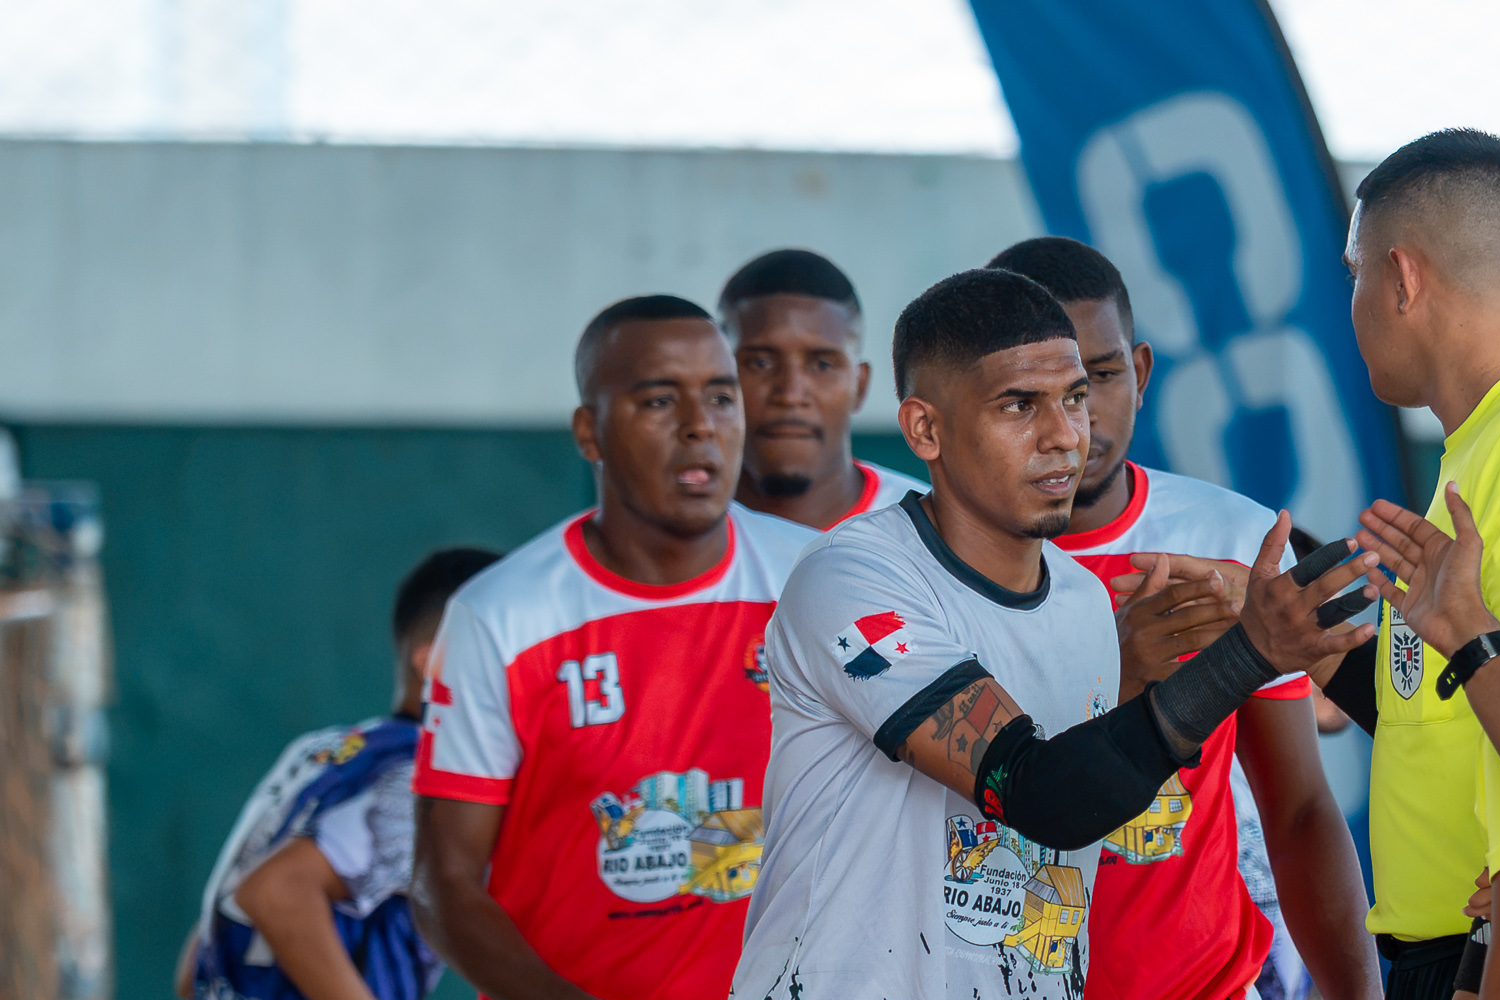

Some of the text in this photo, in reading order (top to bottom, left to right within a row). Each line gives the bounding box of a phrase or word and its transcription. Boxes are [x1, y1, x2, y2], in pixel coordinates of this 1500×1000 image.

[556, 651, 626, 729] 13
[603, 852, 688, 873] RIO ABAJO
[980, 864, 1027, 882] Fundación
[943, 885, 1021, 919] RIO ABAJO
[991, 886, 1012, 897] 1937
